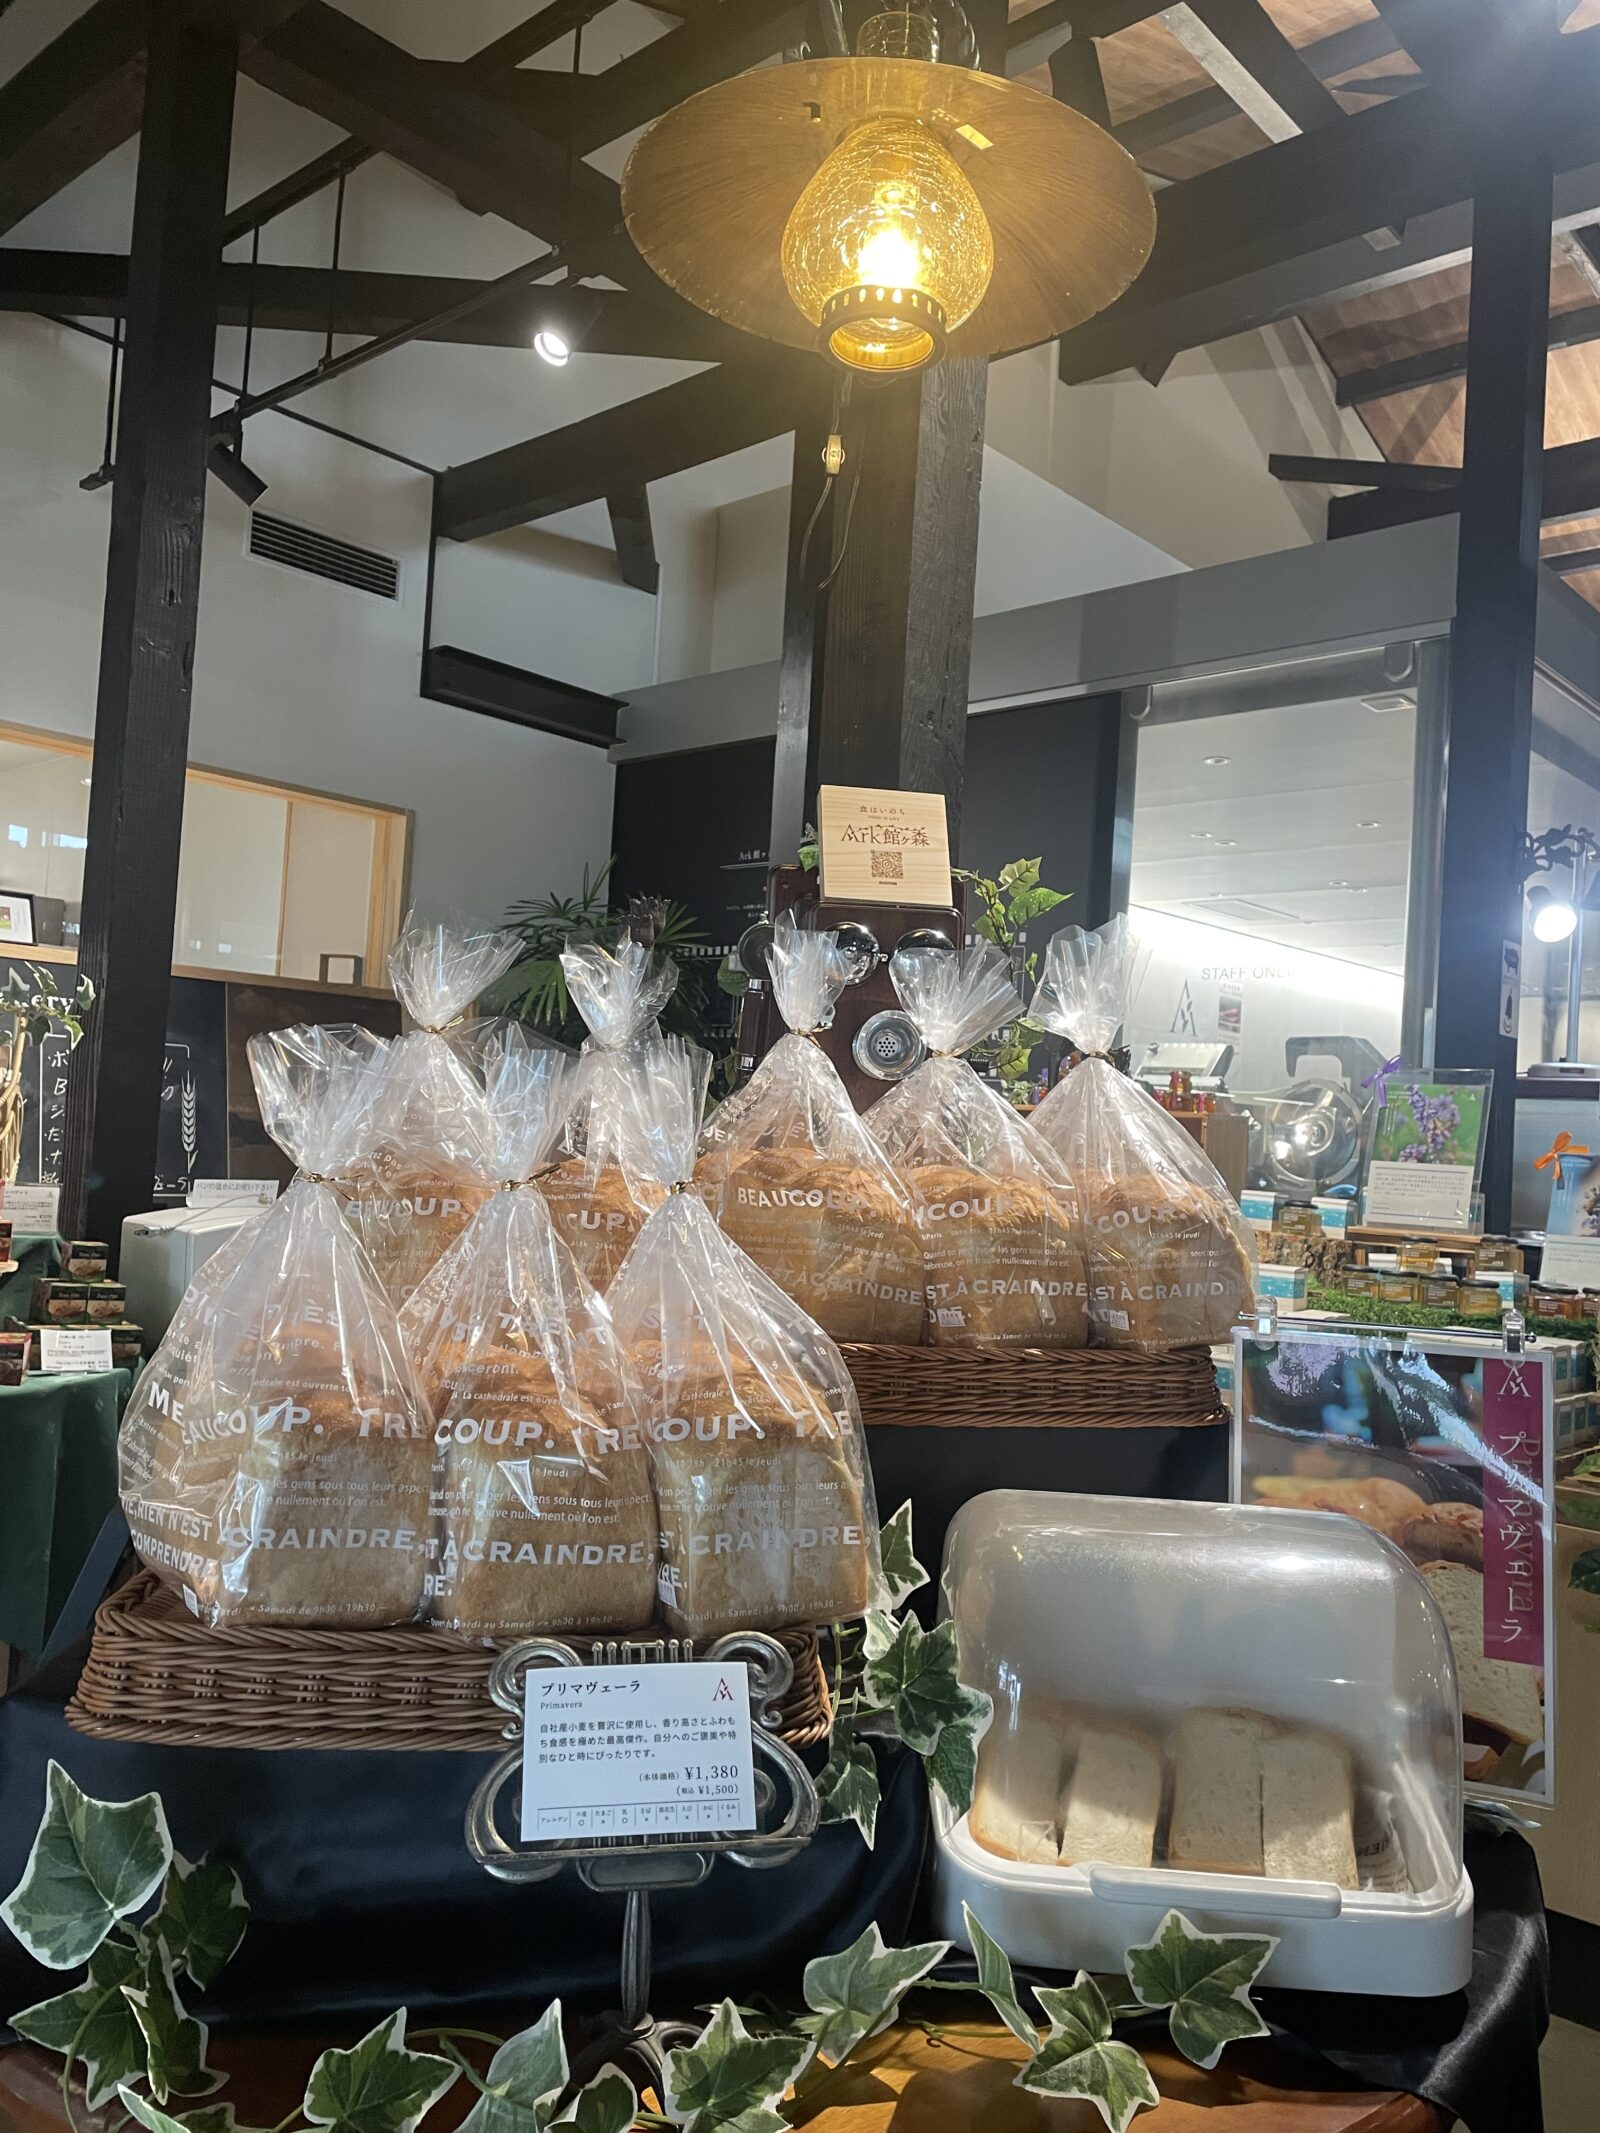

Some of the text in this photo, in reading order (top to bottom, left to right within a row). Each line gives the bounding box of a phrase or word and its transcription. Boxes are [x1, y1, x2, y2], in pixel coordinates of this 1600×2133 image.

[859, 805, 905, 815] 食はいのち
[1201, 967, 1247, 980] STAFF
[311, 1453, 337, 1463] jeudi
[543, 1466, 569, 1477] jeudi
[290, 1480, 316, 1490] gens
[320, 1481, 344, 1490] sous
[372, 1479, 397, 1492] leurs
[275, 1493, 330, 1506] nullement
[554, 1496, 577, 1506] sous
[580, 1497, 602, 1508] tous
[168, 1509, 213, 1542] N'EST
[1497, 1430, 1528, 1643] プマヴェーラ
[462, 1539, 655, 1567] CRAINDRE,
[258, 1604, 295, 1615] Samedi
[347, 1603, 376, 1613] 19h30
[728, 1606, 761, 1619] Samedi
[499, 1618, 535, 1629] Samedi
[542, 1680, 640, 1697] プリマヴェーラ
[541, 1702, 583, 1710] Primavera
[684, 1764, 738, 1782] ¥1,380
